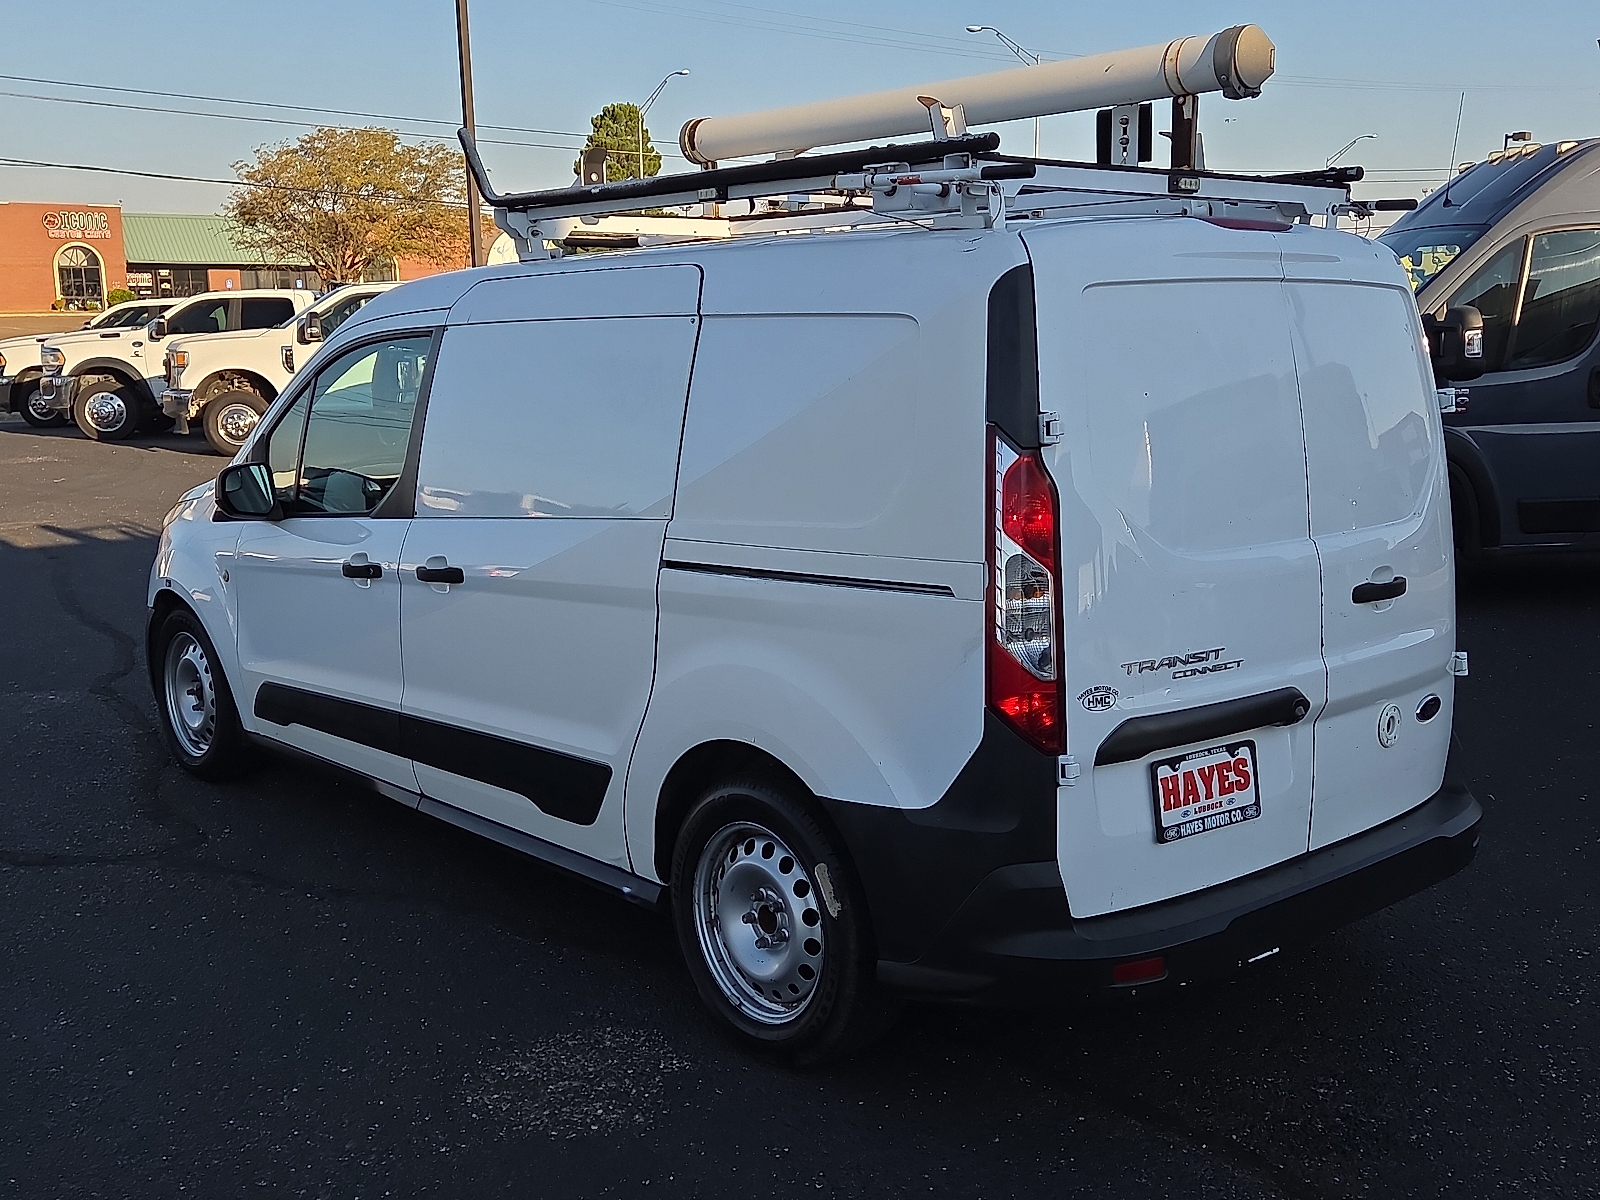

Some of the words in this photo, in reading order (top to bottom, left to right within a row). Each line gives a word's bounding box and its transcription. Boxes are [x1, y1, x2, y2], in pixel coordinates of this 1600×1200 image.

[1121, 647, 1225, 676] TRANSIT
[1171, 659, 1244, 680] CONNECT
[1076, 687, 1093, 702] HAYES
[1087, 693, 1111, 708] HMC
[1210, 746, 1227, 755] TEXAS
[1159, 757, 1251, 812] HAYES
[1193, 801, 1224, 815] LUBBOCK
[1180, 819, 1203, 837] HAYES
[1204, 812, 1230, 829] MOTOR
[1230, 809, 1243, 822] CO.
